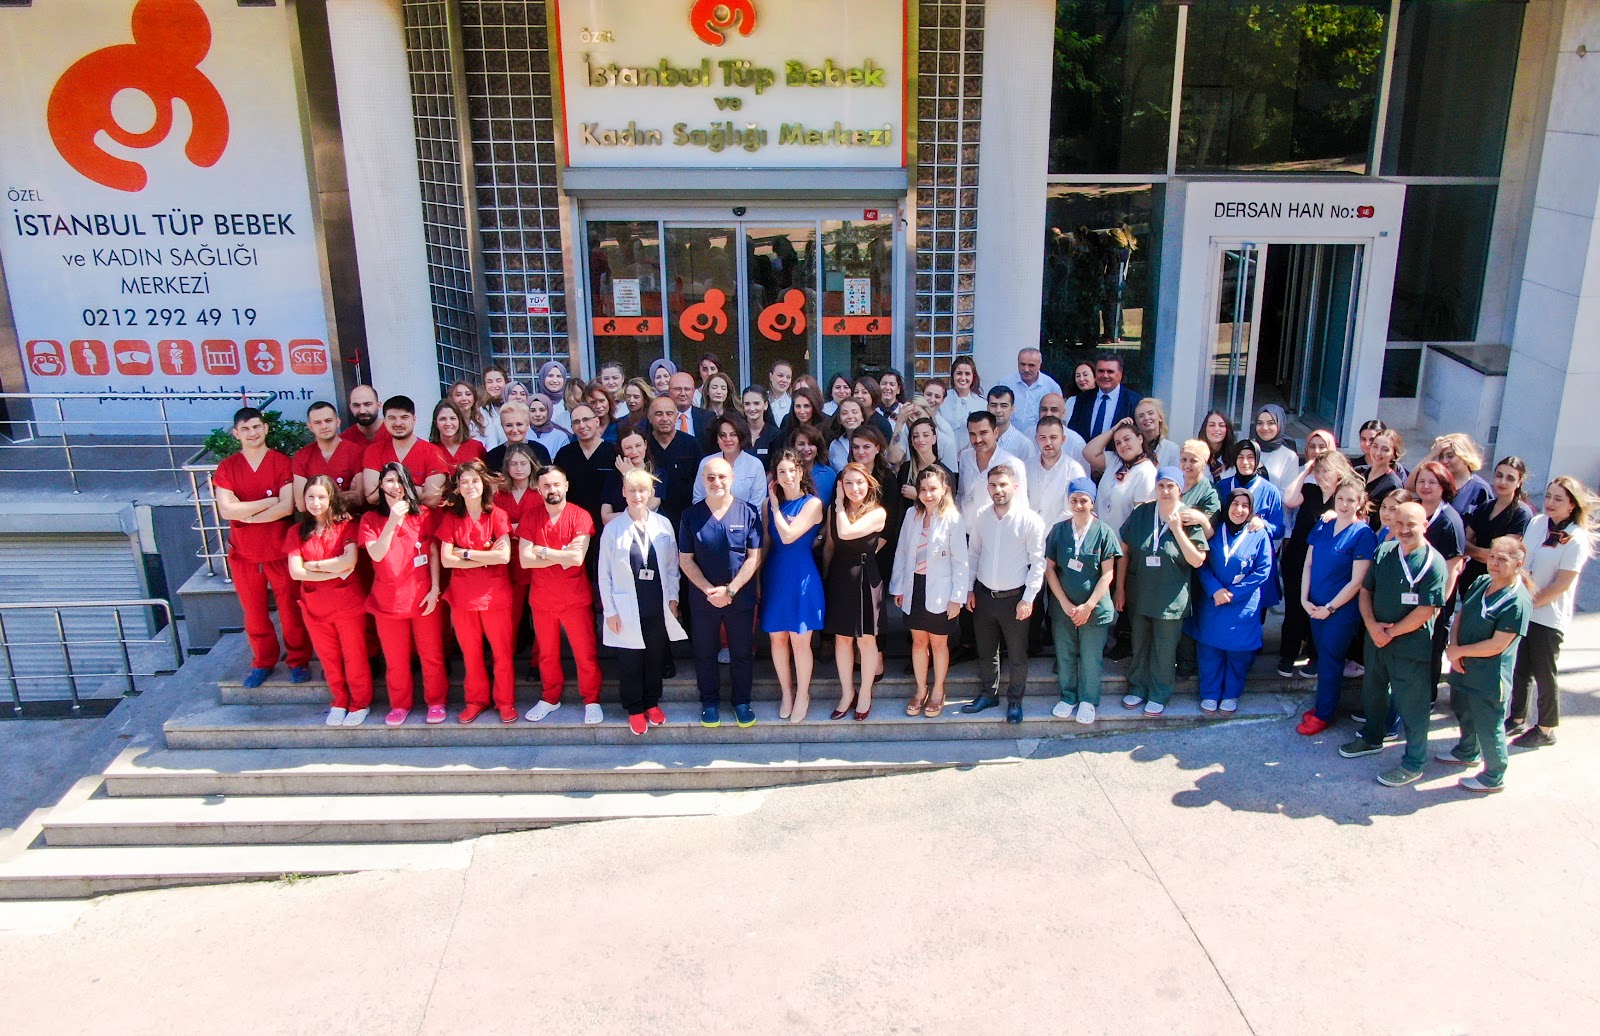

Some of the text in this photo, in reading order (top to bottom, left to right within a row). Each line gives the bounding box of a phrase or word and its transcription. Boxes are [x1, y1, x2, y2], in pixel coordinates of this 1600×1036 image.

[582, 53, 887, 94] İstanbul Tüp Bebek
[714, 96, 743, 111] ve
[579, 121, 892, 152] Kadın Sağlığı Merkezi
[7, 186, 44, 202] ÖZEL
[1214, 202, 1282, 218] DERSAN
[1288, 202, 1324, 218] HAN
[13, 208, 296, 236] İSTANBUL TÜP BEBEK
[62, 243, 259, 267] ve KADIN SAĞLIĞI
[121, 271, 210, 294] MERKEZİ
[83, 308, 257, 326] 0212 292 49 19
[294, 351, 323, 363] SGK
